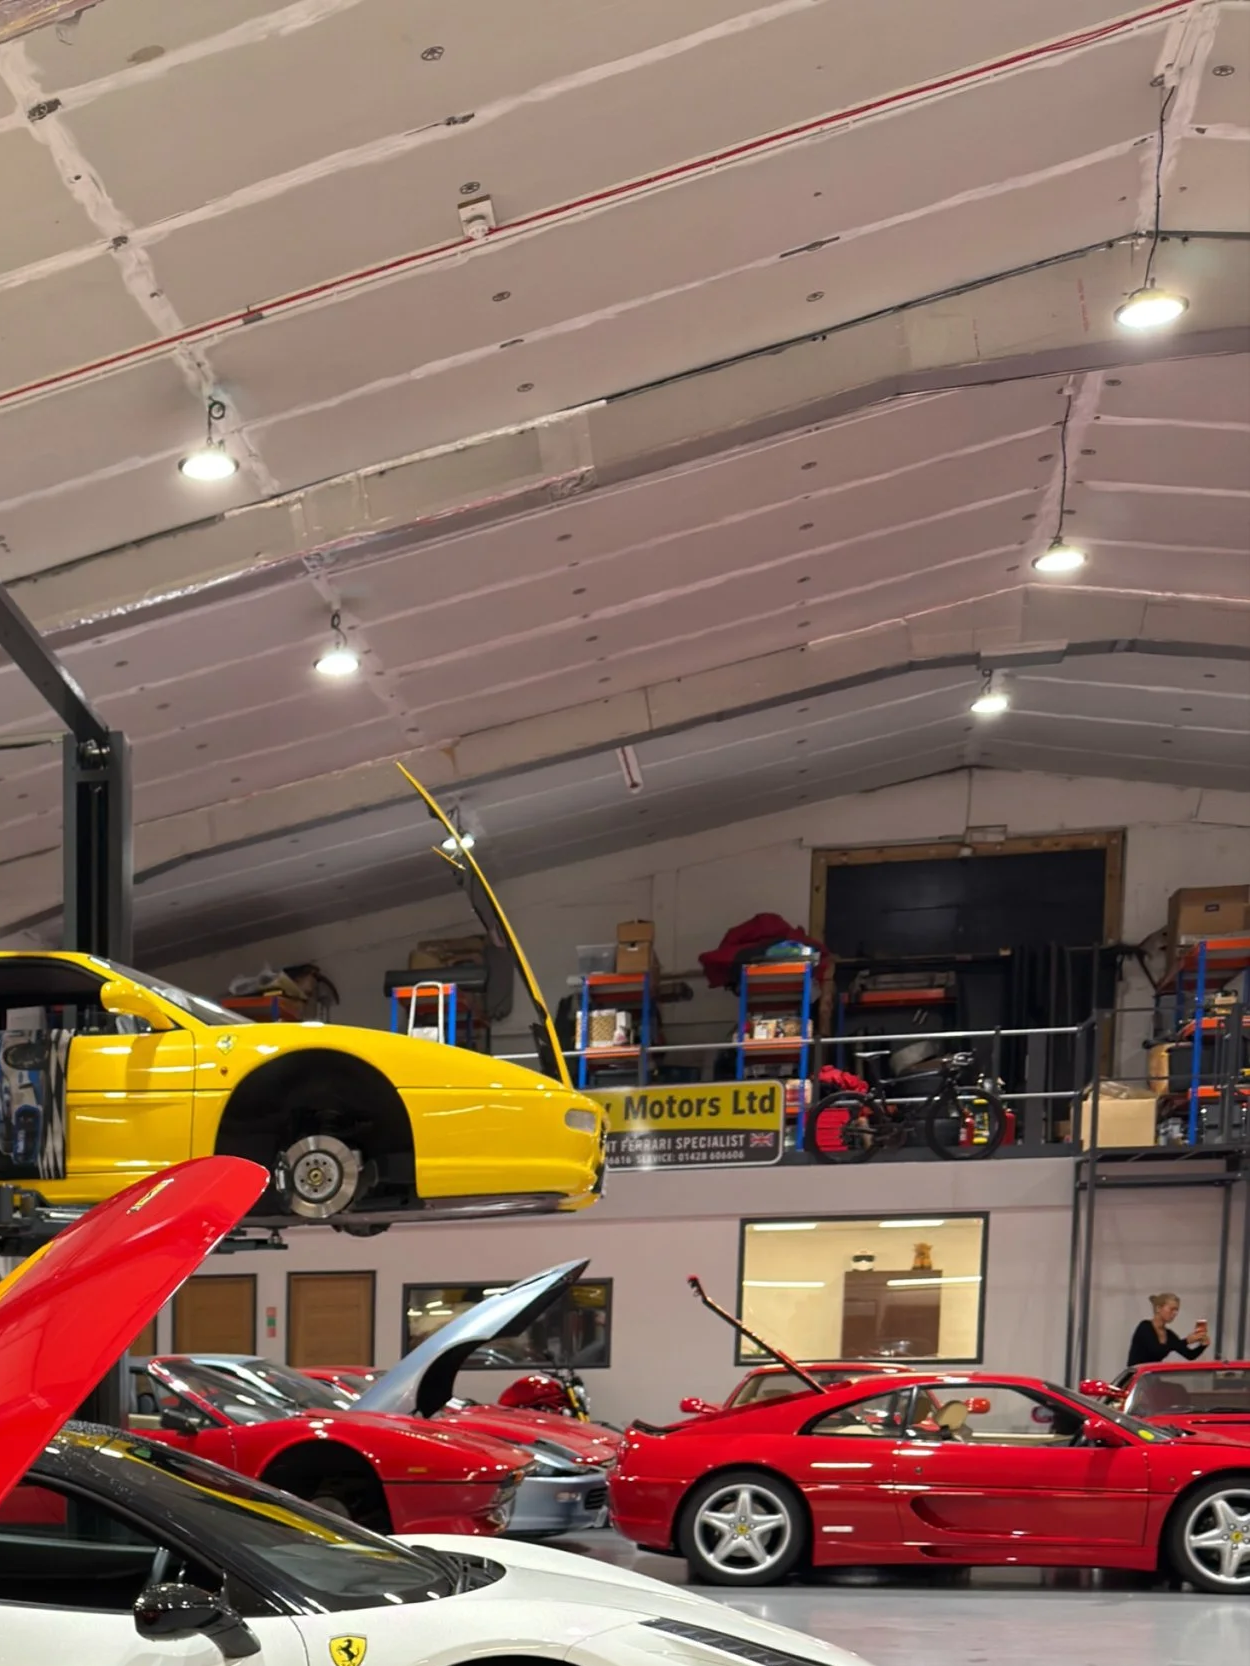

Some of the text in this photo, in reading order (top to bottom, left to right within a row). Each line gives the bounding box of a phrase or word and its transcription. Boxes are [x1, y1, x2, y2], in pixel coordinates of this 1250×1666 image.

[623, 1086, 776, 1121] Motors Ltd
[620, 1138, 672, 1153] FERRARI
[676, 1134, 746, 1151] SPECIALIST
